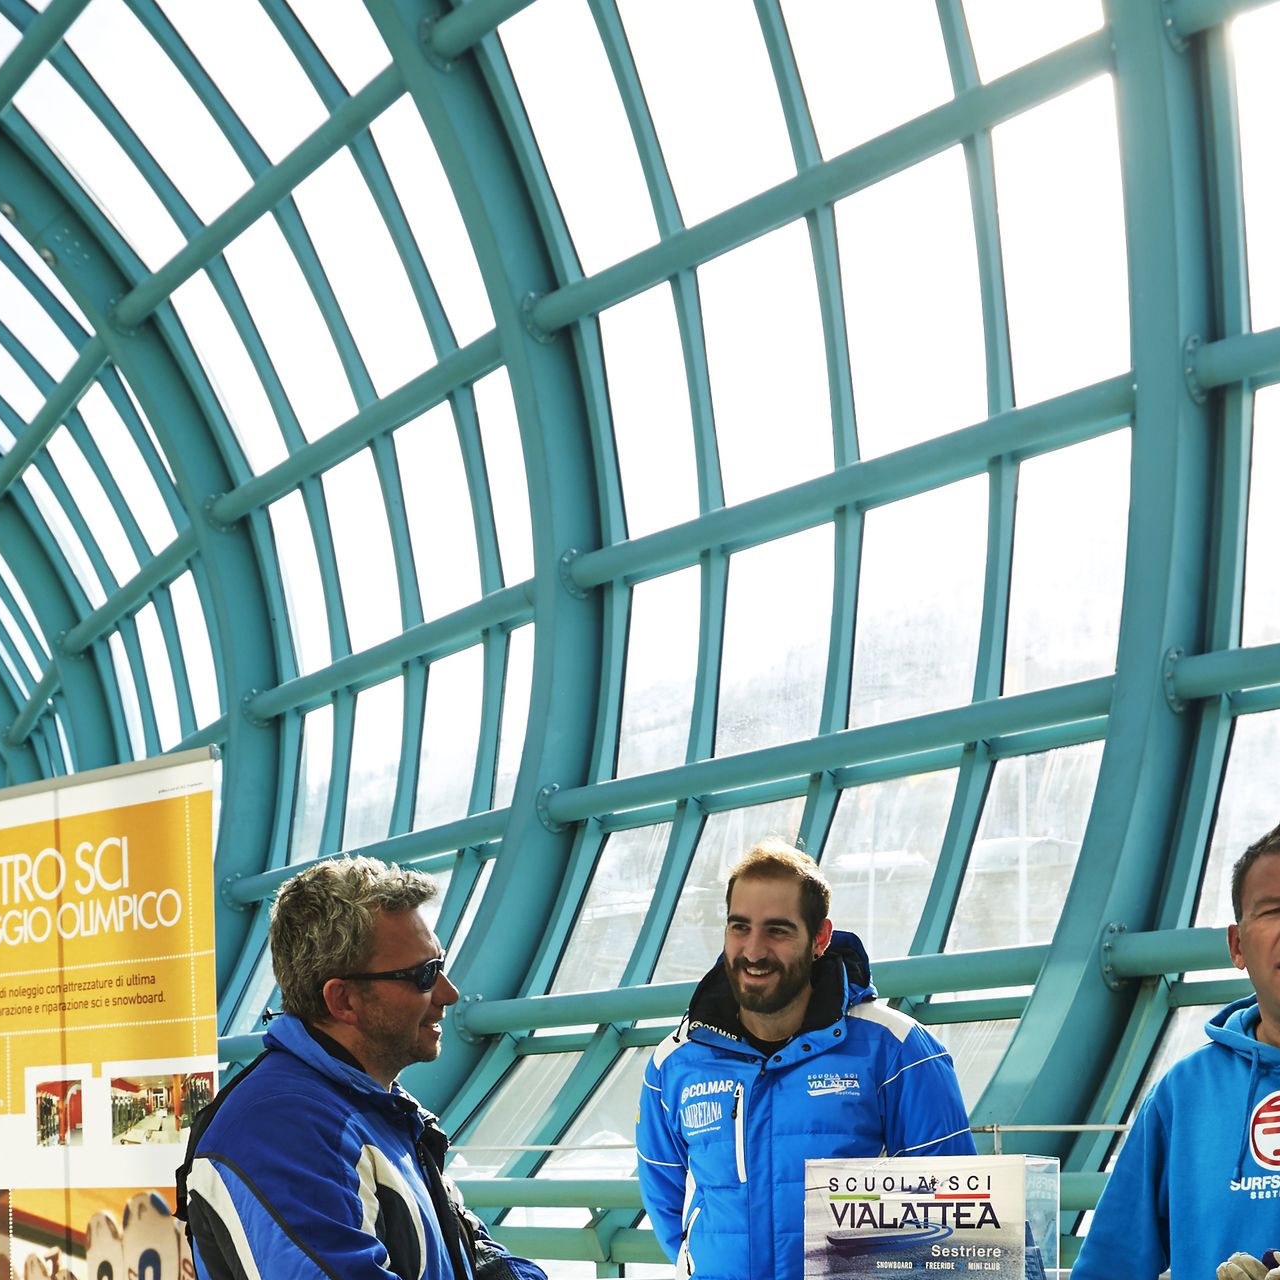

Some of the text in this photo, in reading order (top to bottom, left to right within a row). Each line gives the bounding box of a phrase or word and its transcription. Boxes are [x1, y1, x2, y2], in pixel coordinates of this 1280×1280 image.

[75, 835, 130, 895] SCI
[56, 888, 183, 938] OLIMPICO
[0, 986, 7, 999] di
[8, 984, 45, 999] noleggio
[46, 984, 61, 995] con
[63, 978, 113, 993] attrezzature
[115, 976, 124, 987] di
[126, 973, 156, 986] ultima
[41, 999, 89, 1015] riparazione
[91, 996, 102, 1008] sci
[104, 998, 110, 1007] e
[112, 990, 166, 1007] snowboard.
[689, 1080, 734, 1098] COLMAR
[680, 1101, 722, 1129] LAURETANA
[829, 1175, 991, 1192] SCUOLA SCI
[829, 1202, 1001, 1229] VIALATTEA
[931, 1245, 1002, 1258] Sestriere
[876, 1260, 1001, 1271] SNOWBOARD FREERIDE MINI CLUB
